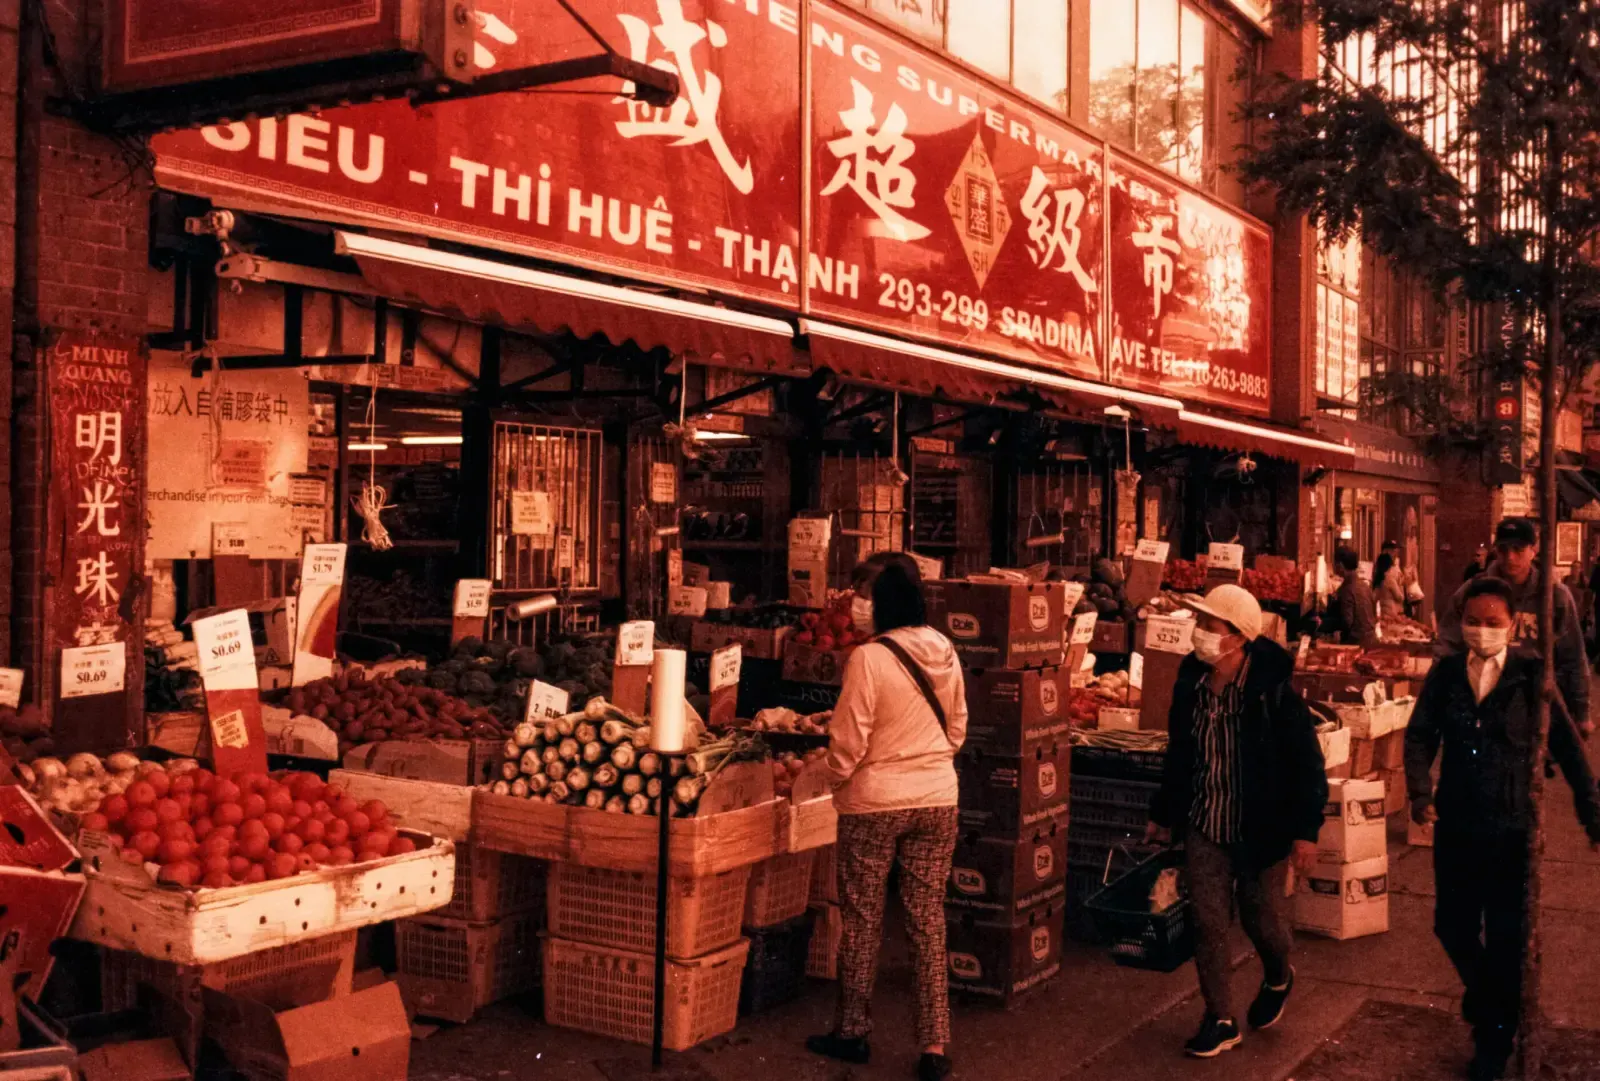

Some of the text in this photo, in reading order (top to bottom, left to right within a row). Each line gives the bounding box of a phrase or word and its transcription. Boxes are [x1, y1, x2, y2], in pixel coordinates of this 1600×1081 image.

[727, 0, 882, 73] ENG
[567, 195, 673, 254] HUÊ
[878, 273, 989, 331] 293-299
[1000, 305, 1095, 358] SPADINA
[71, 345, 129, 366] MINH
[65, 363, 133, 385] QUANG
[147, 488, 206, 502] erchandise
[312, 563, 333, 574] $1.79
[1032, 603, 1046, 618] Dole
[952, 616, 974, 631] Dole
[1156, 634, 1180, 644] $2.29
[211, 640, 241, 660] $0.69
[76, 670, 107, 685] $0.69
